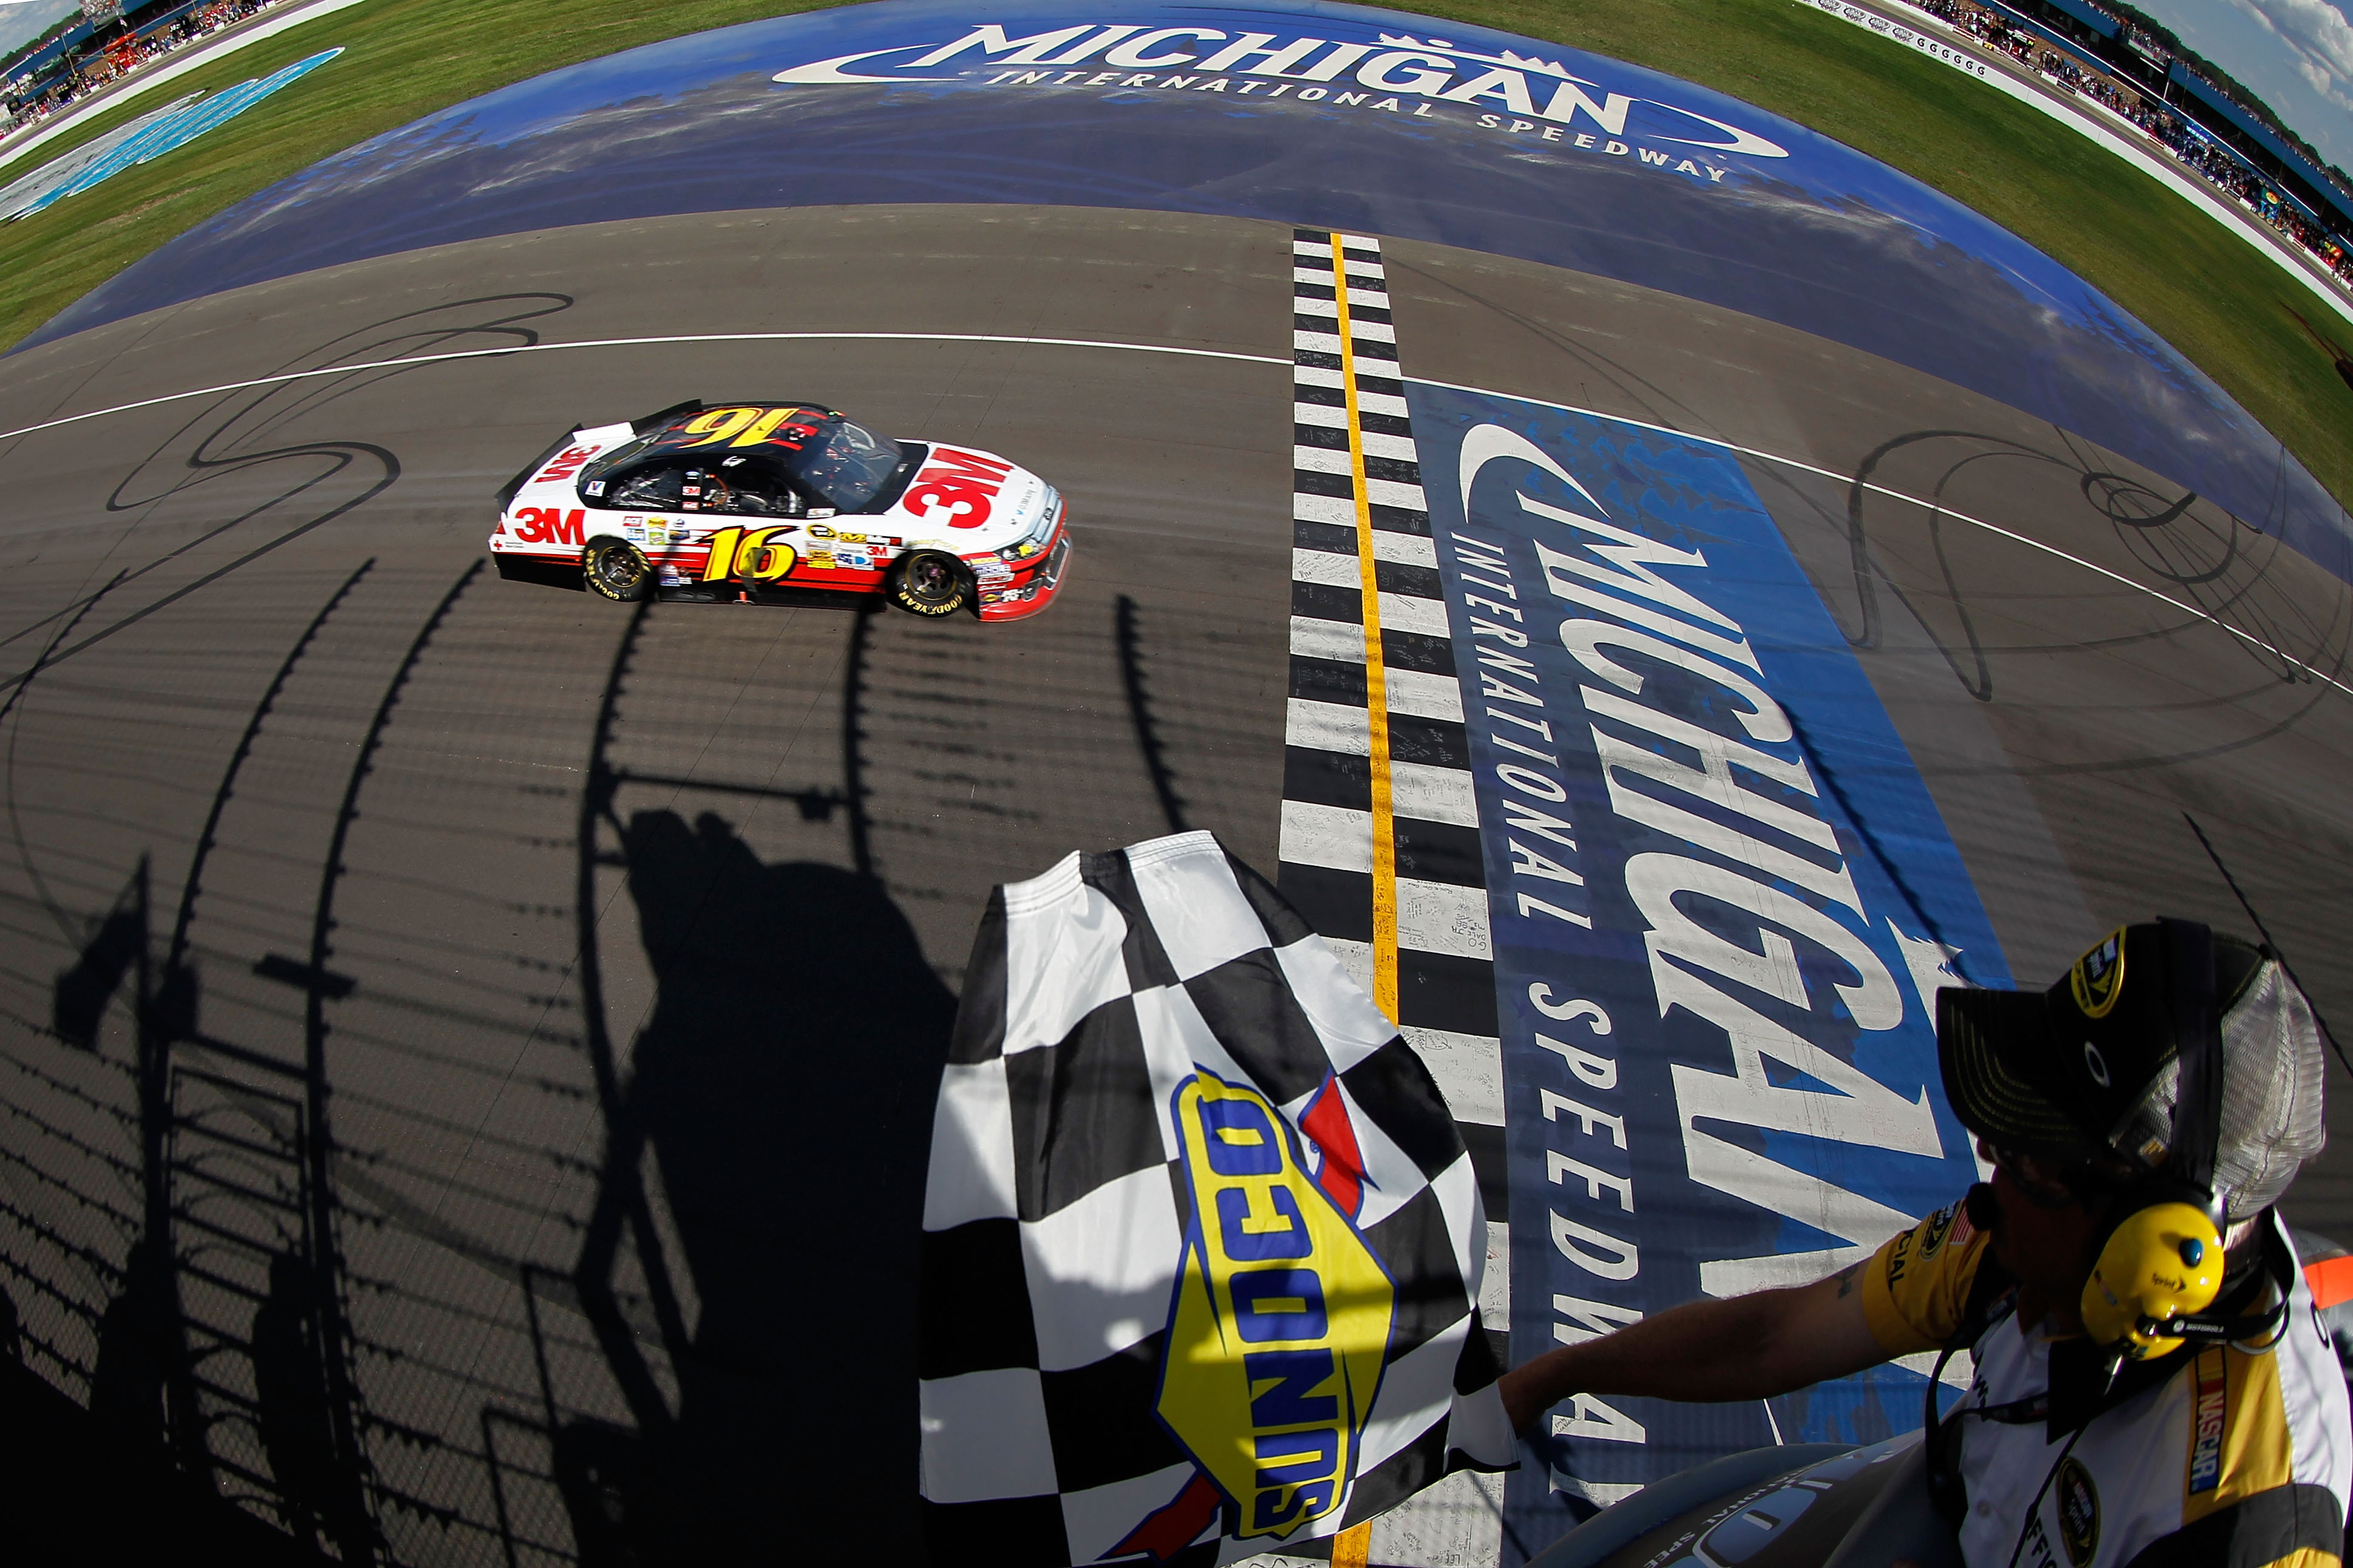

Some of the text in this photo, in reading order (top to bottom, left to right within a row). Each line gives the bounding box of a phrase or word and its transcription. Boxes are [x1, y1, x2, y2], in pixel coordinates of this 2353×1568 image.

[1917, 38, 1986, 76] G G G G G G
[897, 25, 1638, 135] MICHIGAN
[982, 70, 1437, 117] INTERNATIONAL
[1475, 113, 1729, 183] SPEEDWAY
[675, 407, 800, 449] 16
[534, 444, 602, 483] 3M
[903, 447, 1015, 529] 3M
[515, 507, 587, 546] 3M
[703, 526, 797, 581] 16
[866, 546, 888, 557] 3M
[1450, 531, 1592, 929] INTERNATIONAL
[1467, 930, 1486, 940] DALE
[1468, 938, 1487, 951] GO
[1196, 1099, 1340, 1531] SUNOCO
[2186, 1323, 2224, 1333] MOTOROLA
[2191, 1391, 2225, 1480] NASCAR
